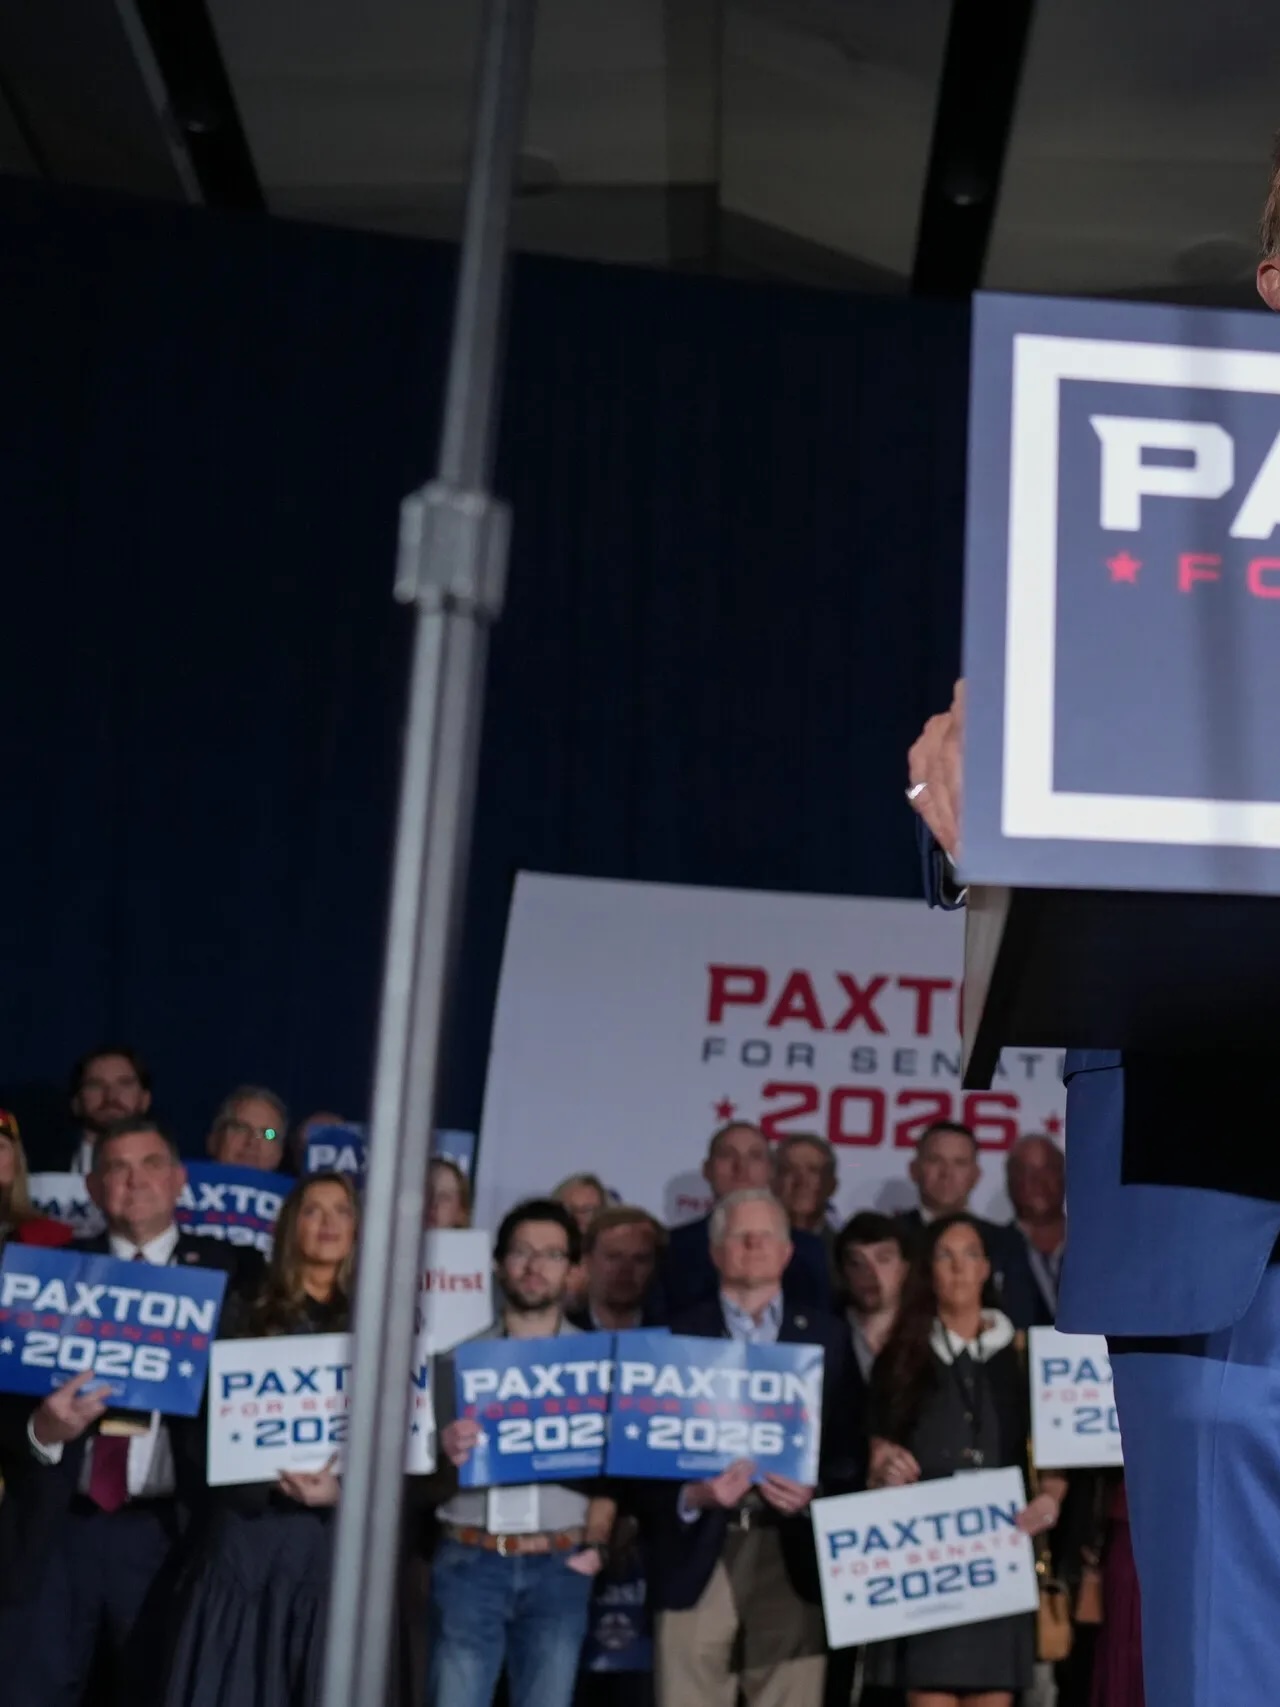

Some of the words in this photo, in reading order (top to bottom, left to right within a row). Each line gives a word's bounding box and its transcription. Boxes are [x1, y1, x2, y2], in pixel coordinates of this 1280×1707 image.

[707, 963, 965, 1038] PAXT
[702, 1036, 816, 1069] FOR
[850, 1046, 1065, 1080] SENT
[759, 1082, 1021, 1151] 2026
[1, 1271, 217, 1334] PAXTON
[420, 1268, 485, 1293] First
[21, 1329, 171, 1382] 2026
[620, 1361, 813, 1404] PAXTON
[256, 1415, 350, 1448] 202
[497, 1412, 605, 1455] 202
[646, 1415, 785, 1456] 2026
[826, 1500, 1019, 1560] PAXTON
[864, 1557, 997, 1607] 2026
